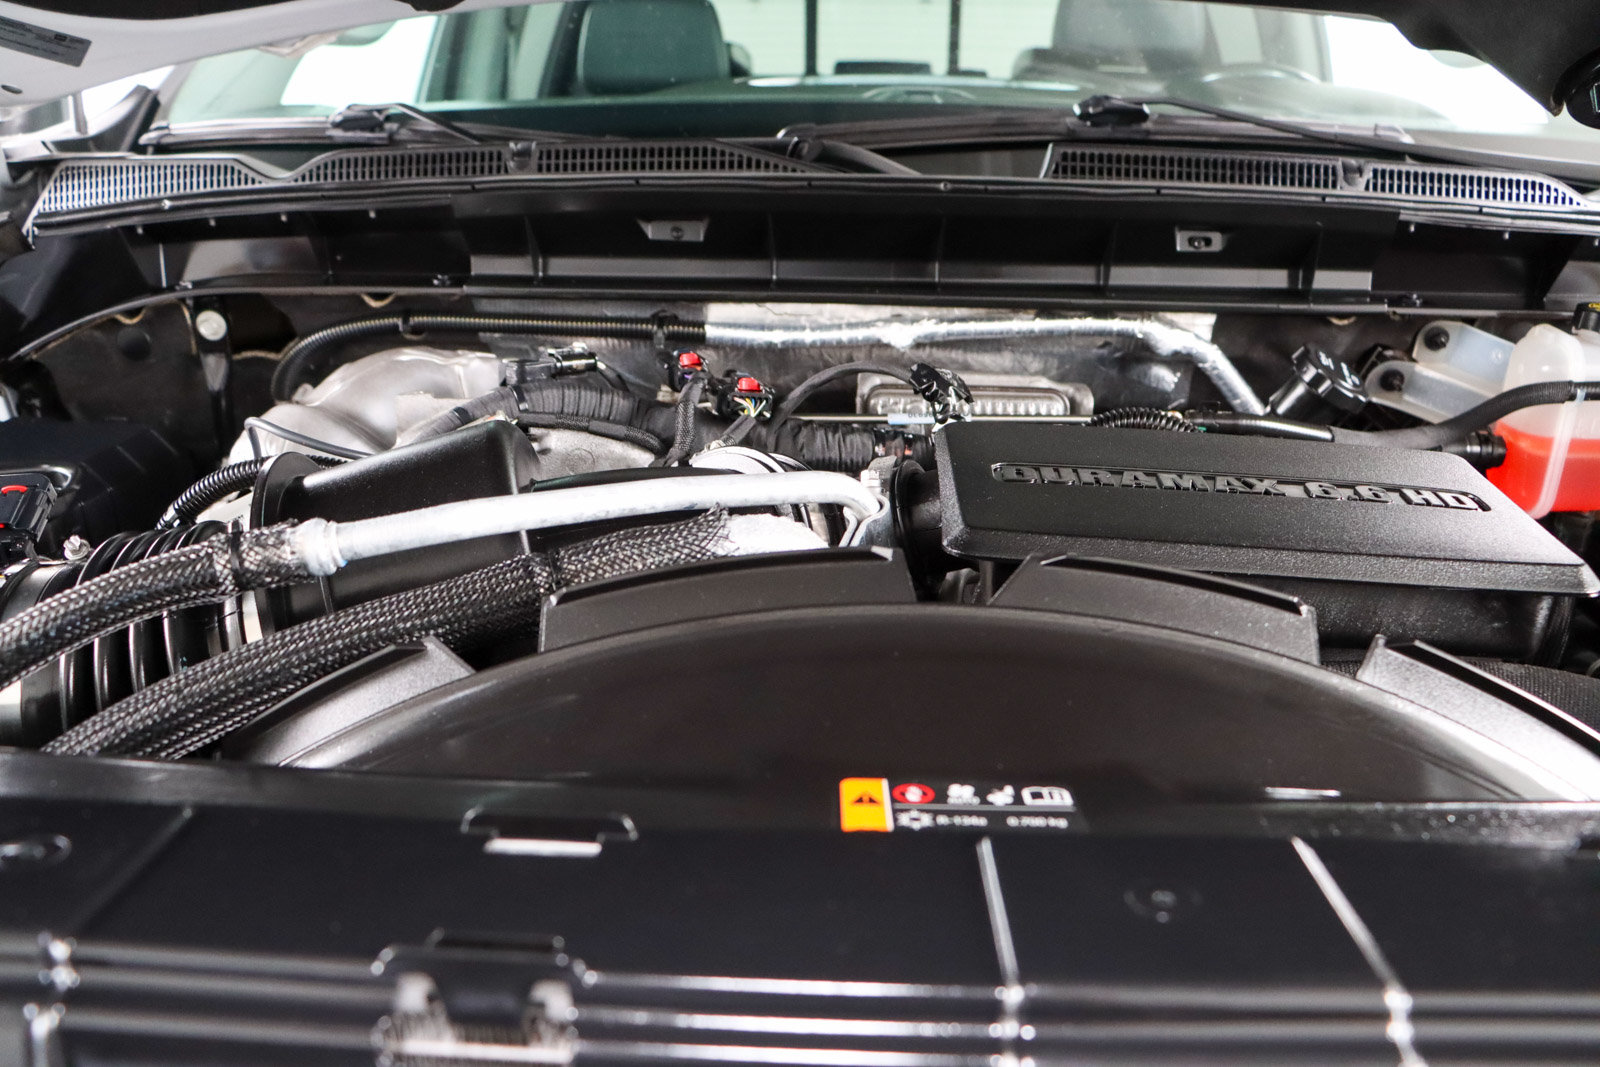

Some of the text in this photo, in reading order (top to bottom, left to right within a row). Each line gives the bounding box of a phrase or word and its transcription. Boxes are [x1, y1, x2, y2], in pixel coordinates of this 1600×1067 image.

[1001, 465, 1478, 511] DURAMAX 6.6 HD
